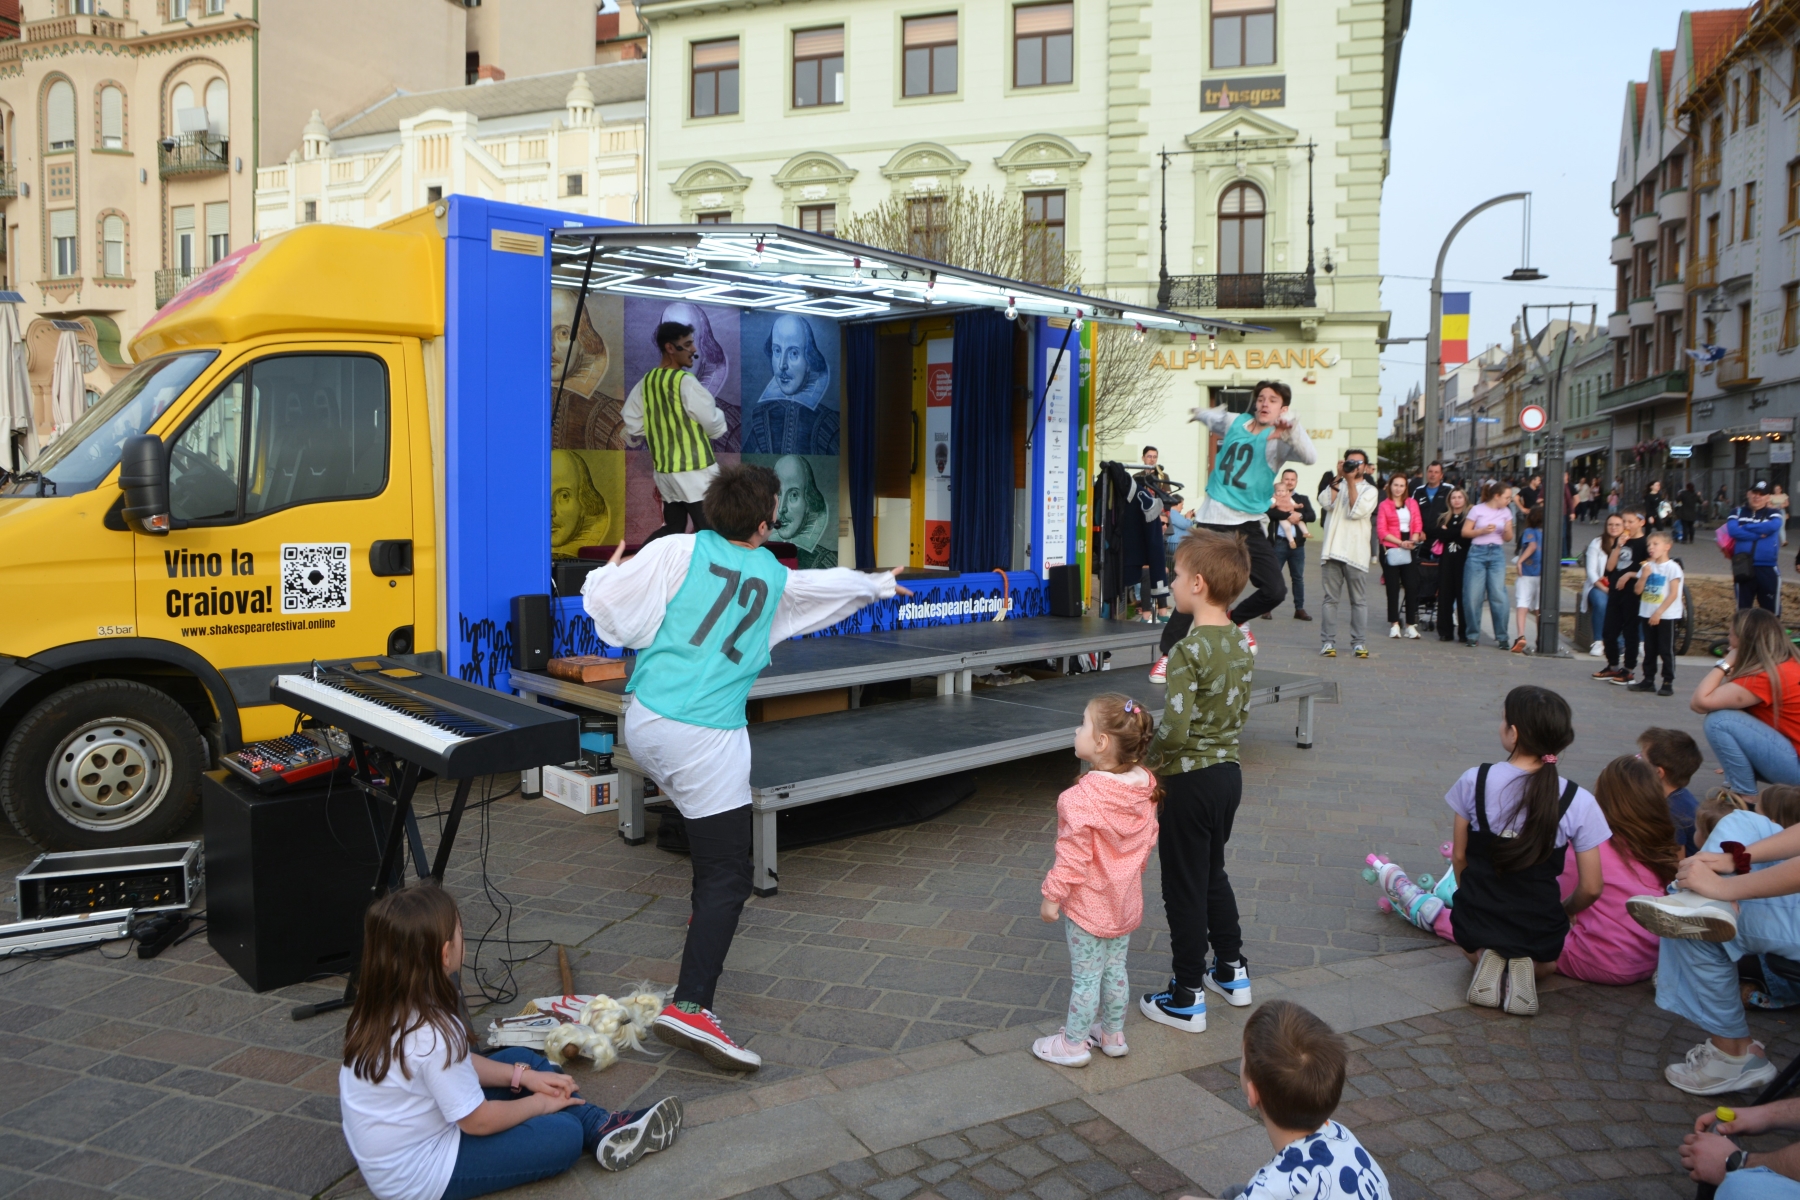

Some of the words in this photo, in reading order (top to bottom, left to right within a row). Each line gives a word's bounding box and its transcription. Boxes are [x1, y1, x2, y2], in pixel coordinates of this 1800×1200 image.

[1150, 350, 1240, 369] ALPHA
[1246, 348, 1329, 368] BANK
[1219, 441, 1254, 490] 42
[164, 548, 222, 578] Vino
[231, 548, 254, 576] la
[165, 585, 272, 618] Craiova!
[688, 562, 768, 665] 72
[898, 595, 1013, 621] #ShakespeareLaCraioa
[115, 625, 133, 635] bar
[181, 618, 336, 637] www.shakespearefestival.online
